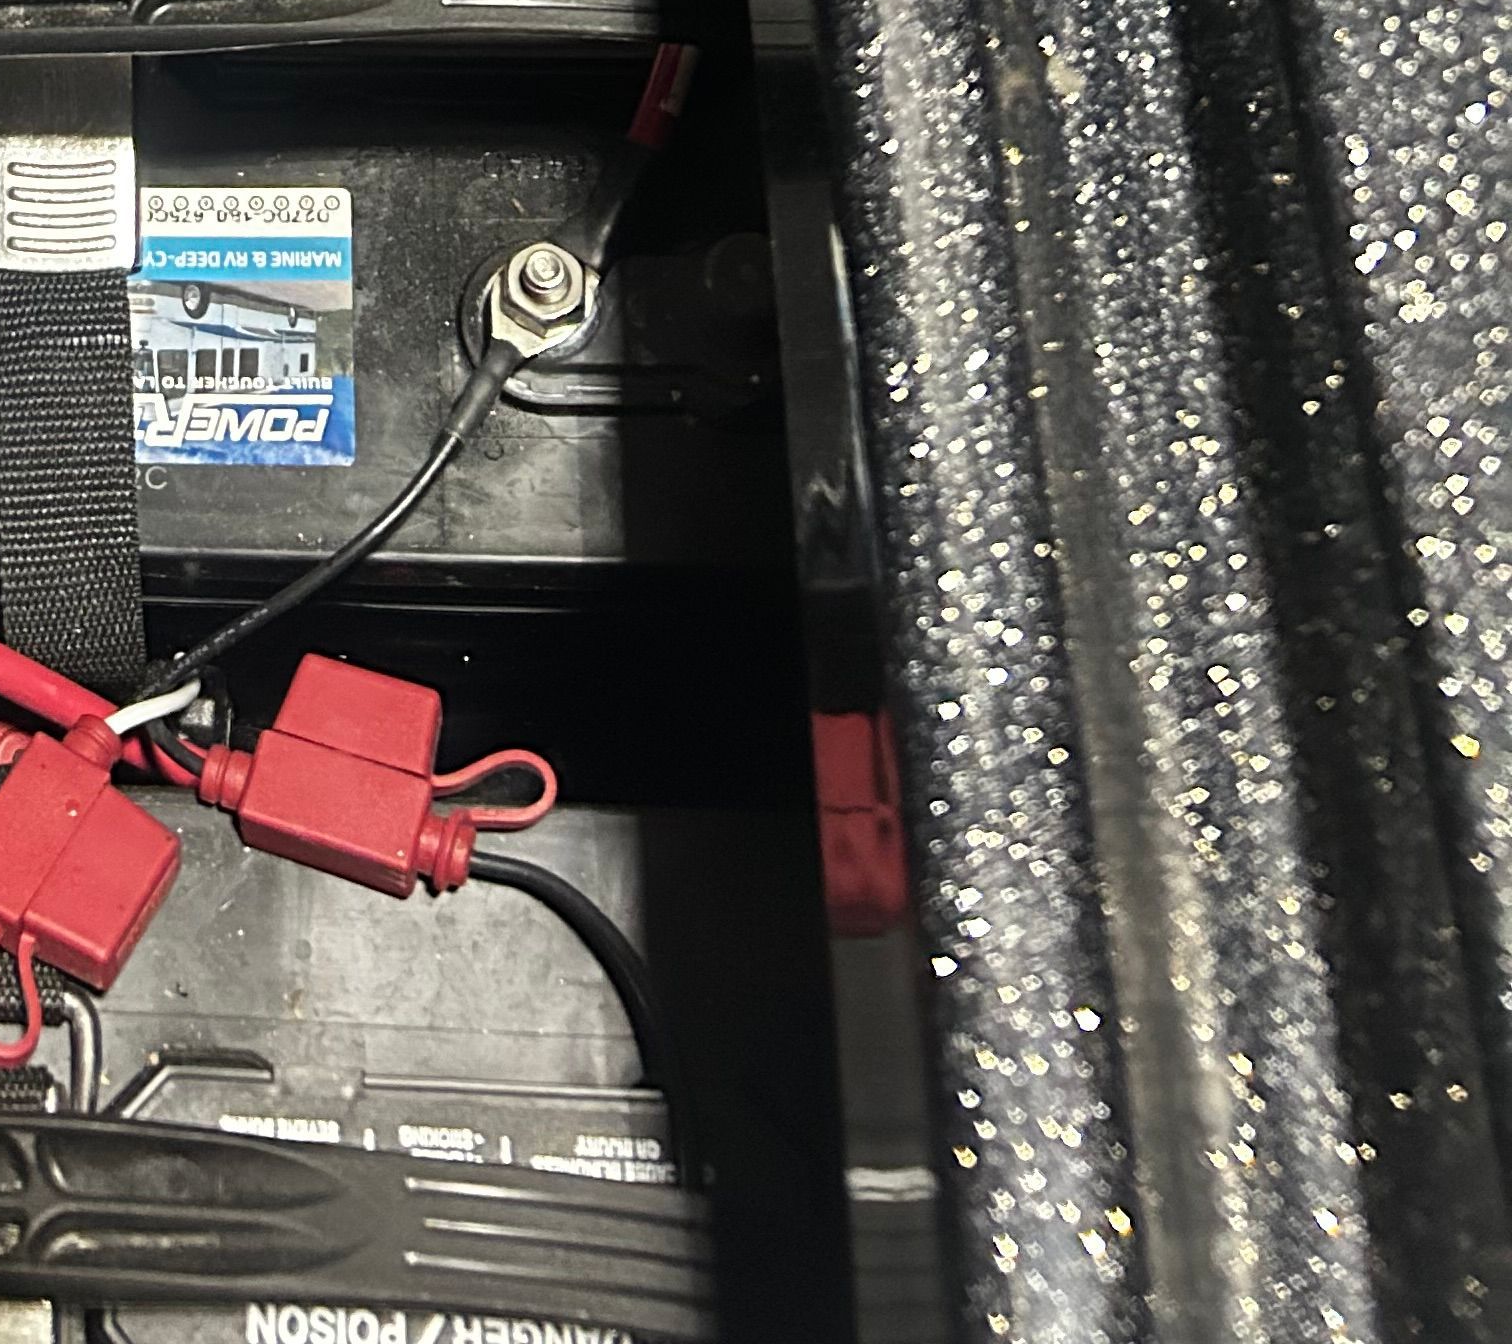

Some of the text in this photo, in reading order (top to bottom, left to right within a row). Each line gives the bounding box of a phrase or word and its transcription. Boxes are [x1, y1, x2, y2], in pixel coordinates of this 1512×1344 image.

[226, 251, 249, 268] RV
[251, 251, 268, 268] &
[271, 251, 342, 269] MARINE
[162, 377, 187, 390] TO
[190, 377, 274, 391] TOUGHER
[133, 393, 331, 448] POWER
[248, 1301, 409, 1344] POISON
